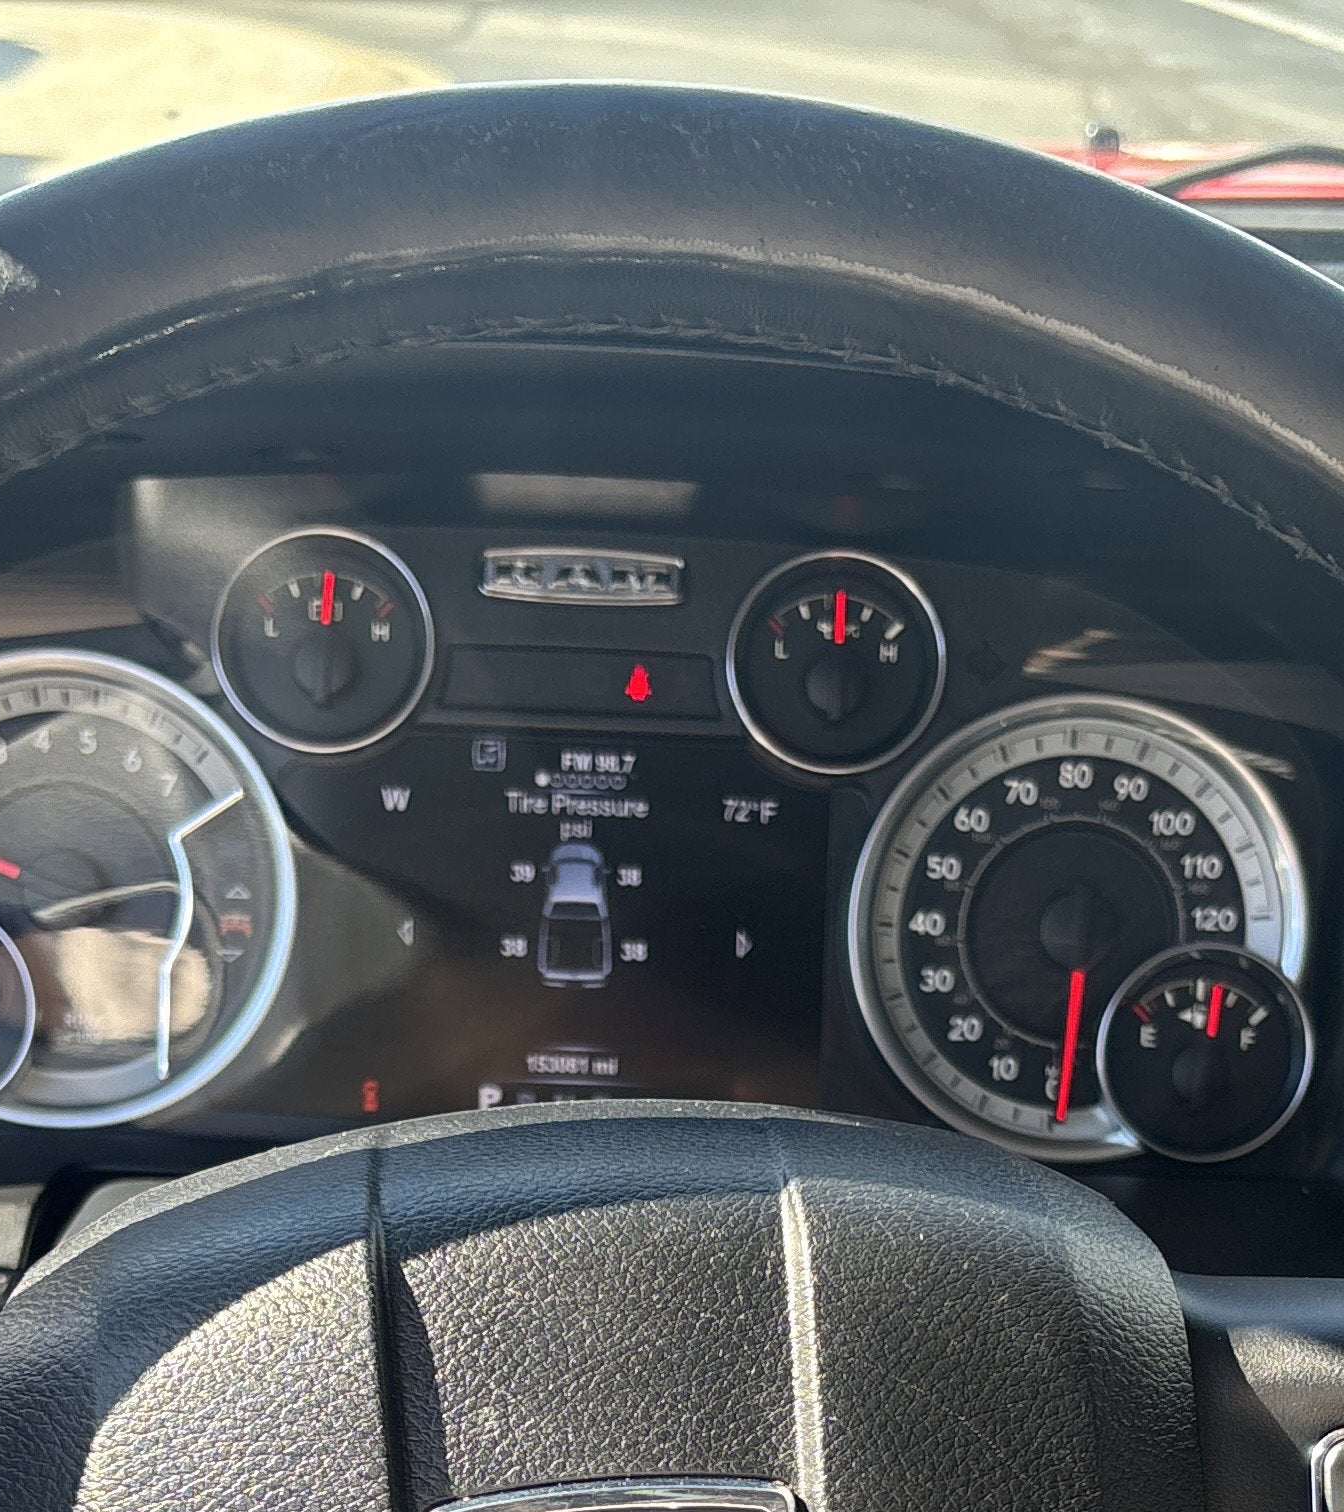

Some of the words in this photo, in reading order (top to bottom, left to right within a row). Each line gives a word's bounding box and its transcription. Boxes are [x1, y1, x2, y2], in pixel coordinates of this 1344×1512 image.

[263, 616, 280, 638] L
[370, 621, 391, 642] H
[774, 639, 790, 660] L
[878, 641, 899, 663] H
[34, 727, 54, 754] 4
[78, 727, 98, 755] 5
[122, 747, 144, 773] 6
[560, 750, 593, 772] FM
[159, 773, 179, 798] 7
[1058, 762, 1094, 790] 80
[1112, 775, 1150, 803] 90
[380, 786, 411, 813] W
[504, 789, 549, 815] Tire
[551, 793, 651, 819] Pressure
[1003, 780, 1039, 807] 70
[560, 820, 593, 842] psi
[954, 807, 990, 834] 60
[1148, 810, 1197, 837] 100
[925, 855, 961, 881] 50
[1180, 854, 1224, 881] 110
[908, 911, 946, 937] 40
[1190, 907, 1238, 934] 120
[918, 968, 955, 993] 30
[947, 1017, 984, 1042] 20
[1140, 1023, 1157, 1048] E
[1240, 1027, 1258, 1052] F
[988, 1056, 1021, 1082] 10
[478, 1083, 504, 1110] P
